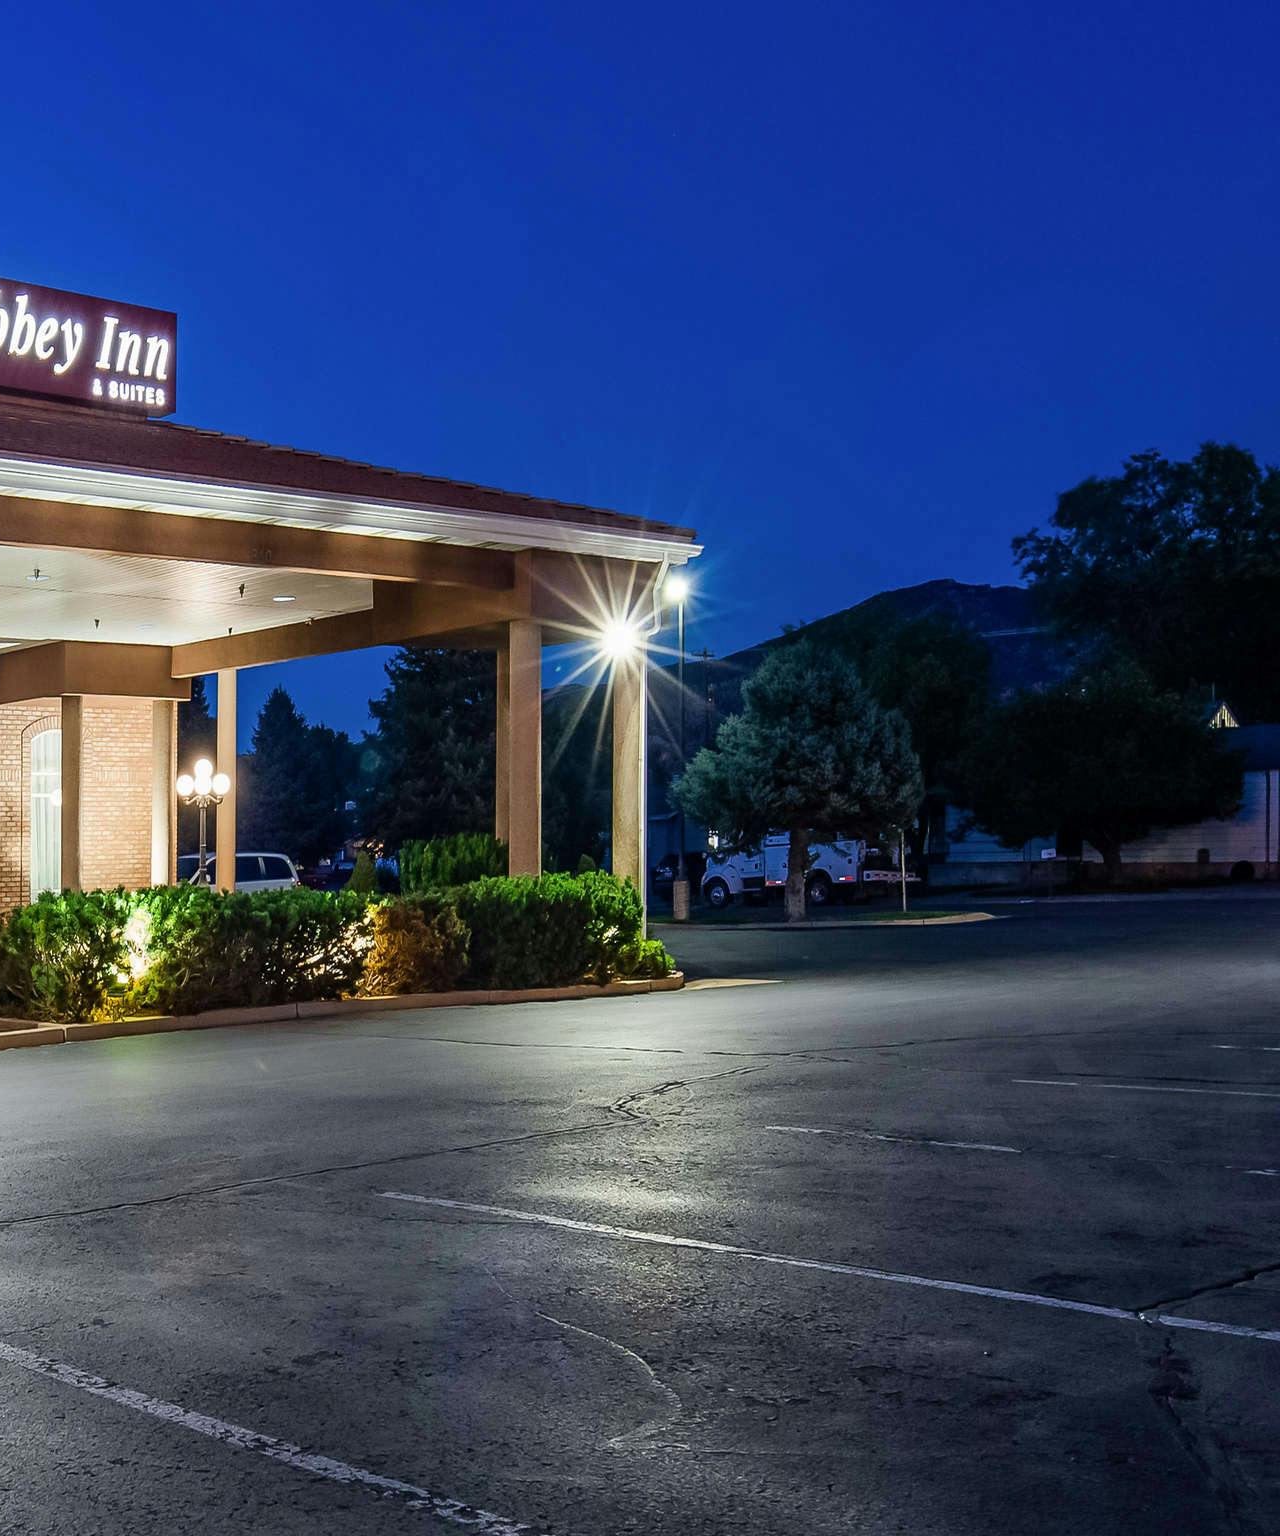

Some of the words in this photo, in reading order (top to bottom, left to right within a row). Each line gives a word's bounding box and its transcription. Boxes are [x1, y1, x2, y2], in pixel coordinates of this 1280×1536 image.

[95, 316, 169, 380] Inn
[92, 378, 103, 396] &
[108, 380, 166, 406] SUITES
